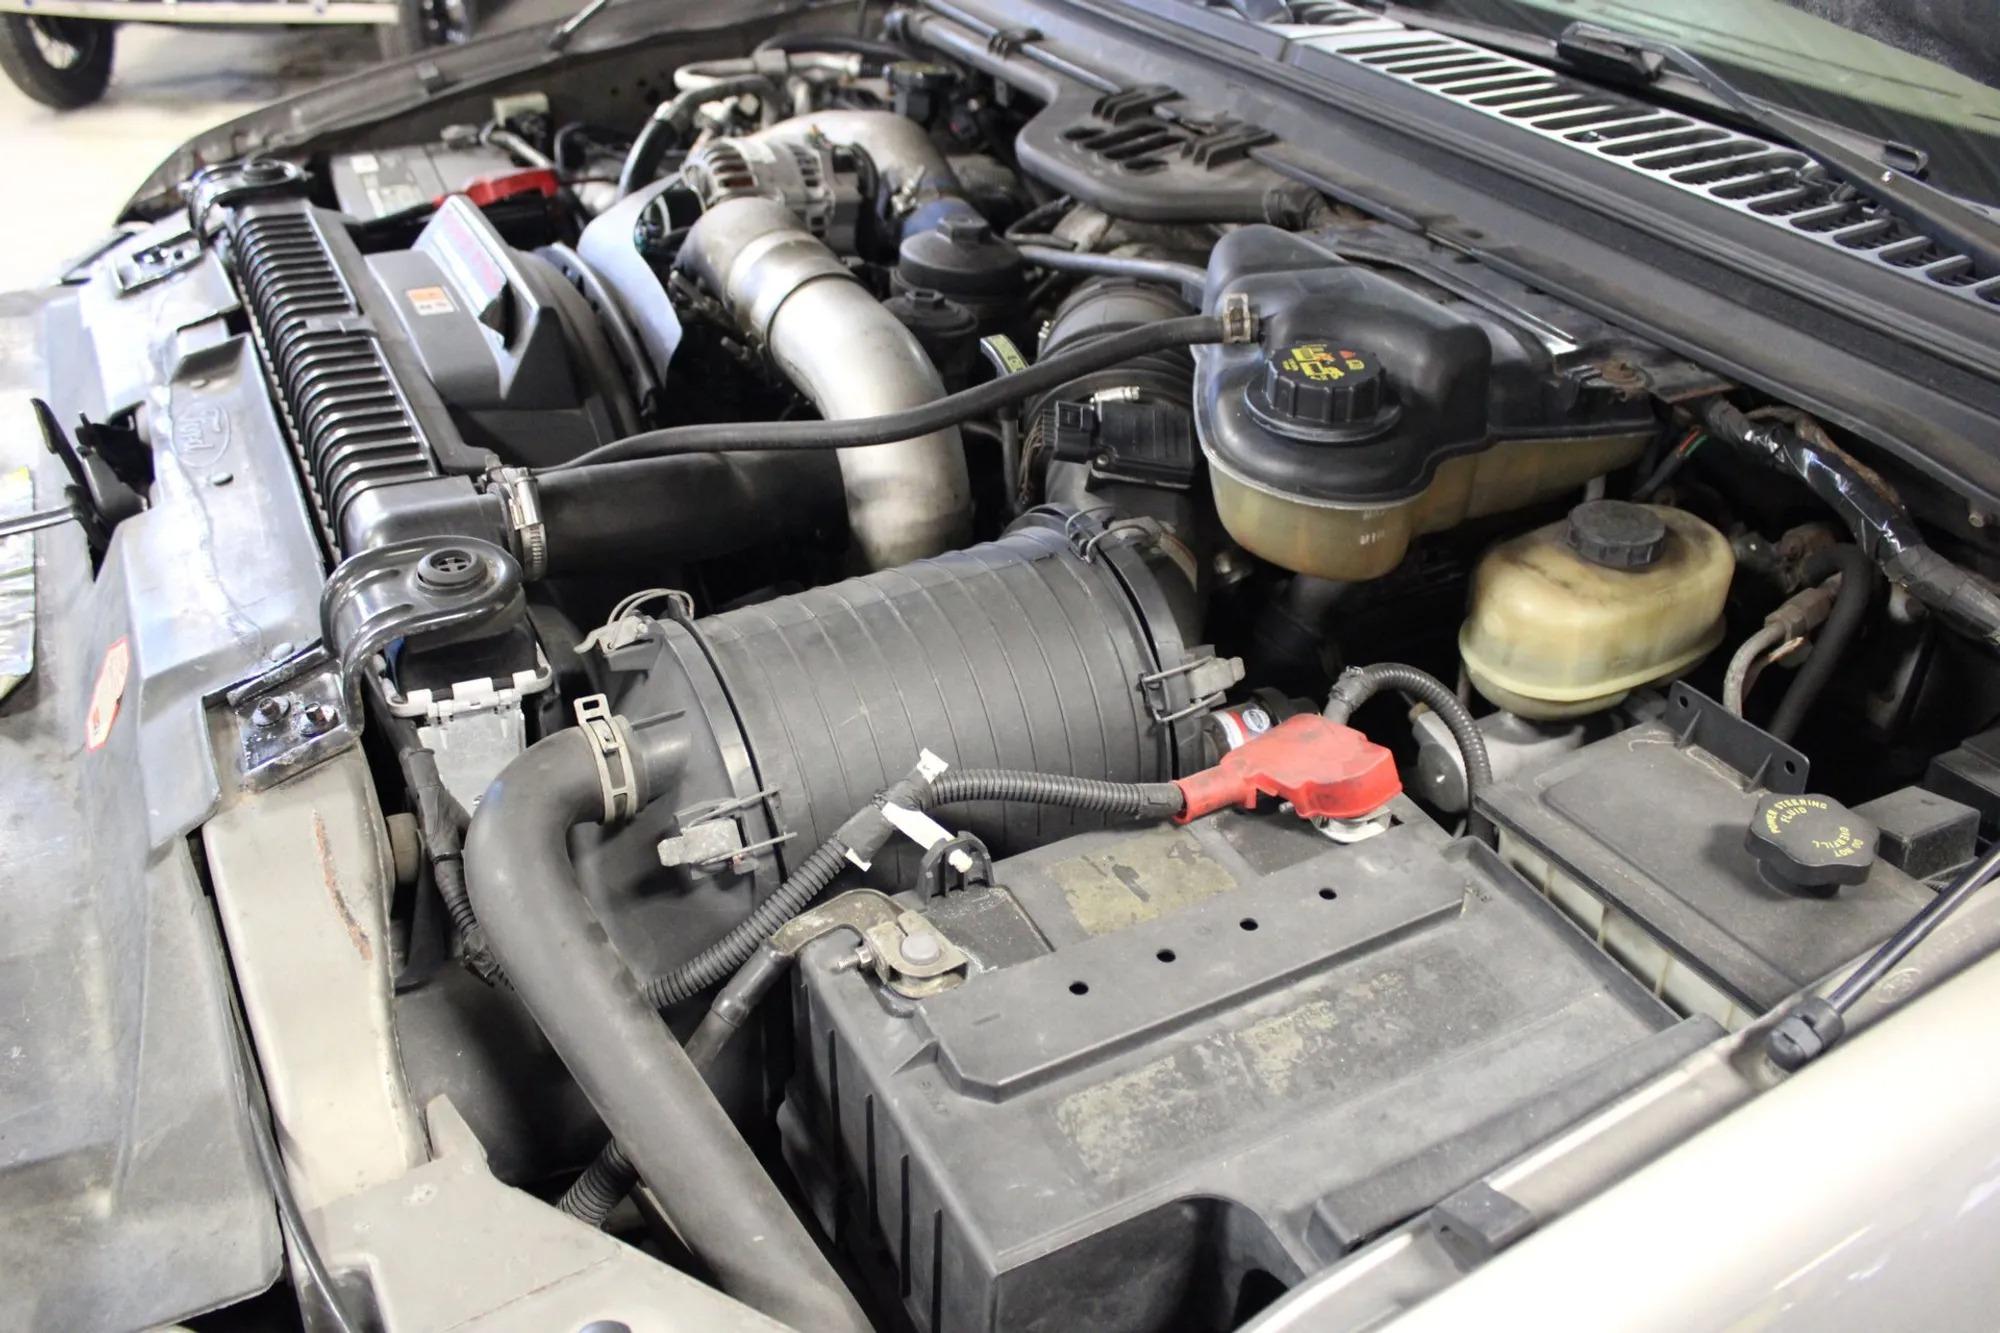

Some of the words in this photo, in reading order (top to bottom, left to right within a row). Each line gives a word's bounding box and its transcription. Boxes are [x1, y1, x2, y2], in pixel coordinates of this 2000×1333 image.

[177, 405, 222, 451] Ford
[1766, 809, 1782, 834] POWER
[1774, 798, 1828, 810] STEERING
[1780, 806, 1808, 824] FLUID
[1811, 826, 1851, 849] OVERFILL
[1851, 838, 1864, 849] DO
[1834, 847, 1855, 858] NOT
